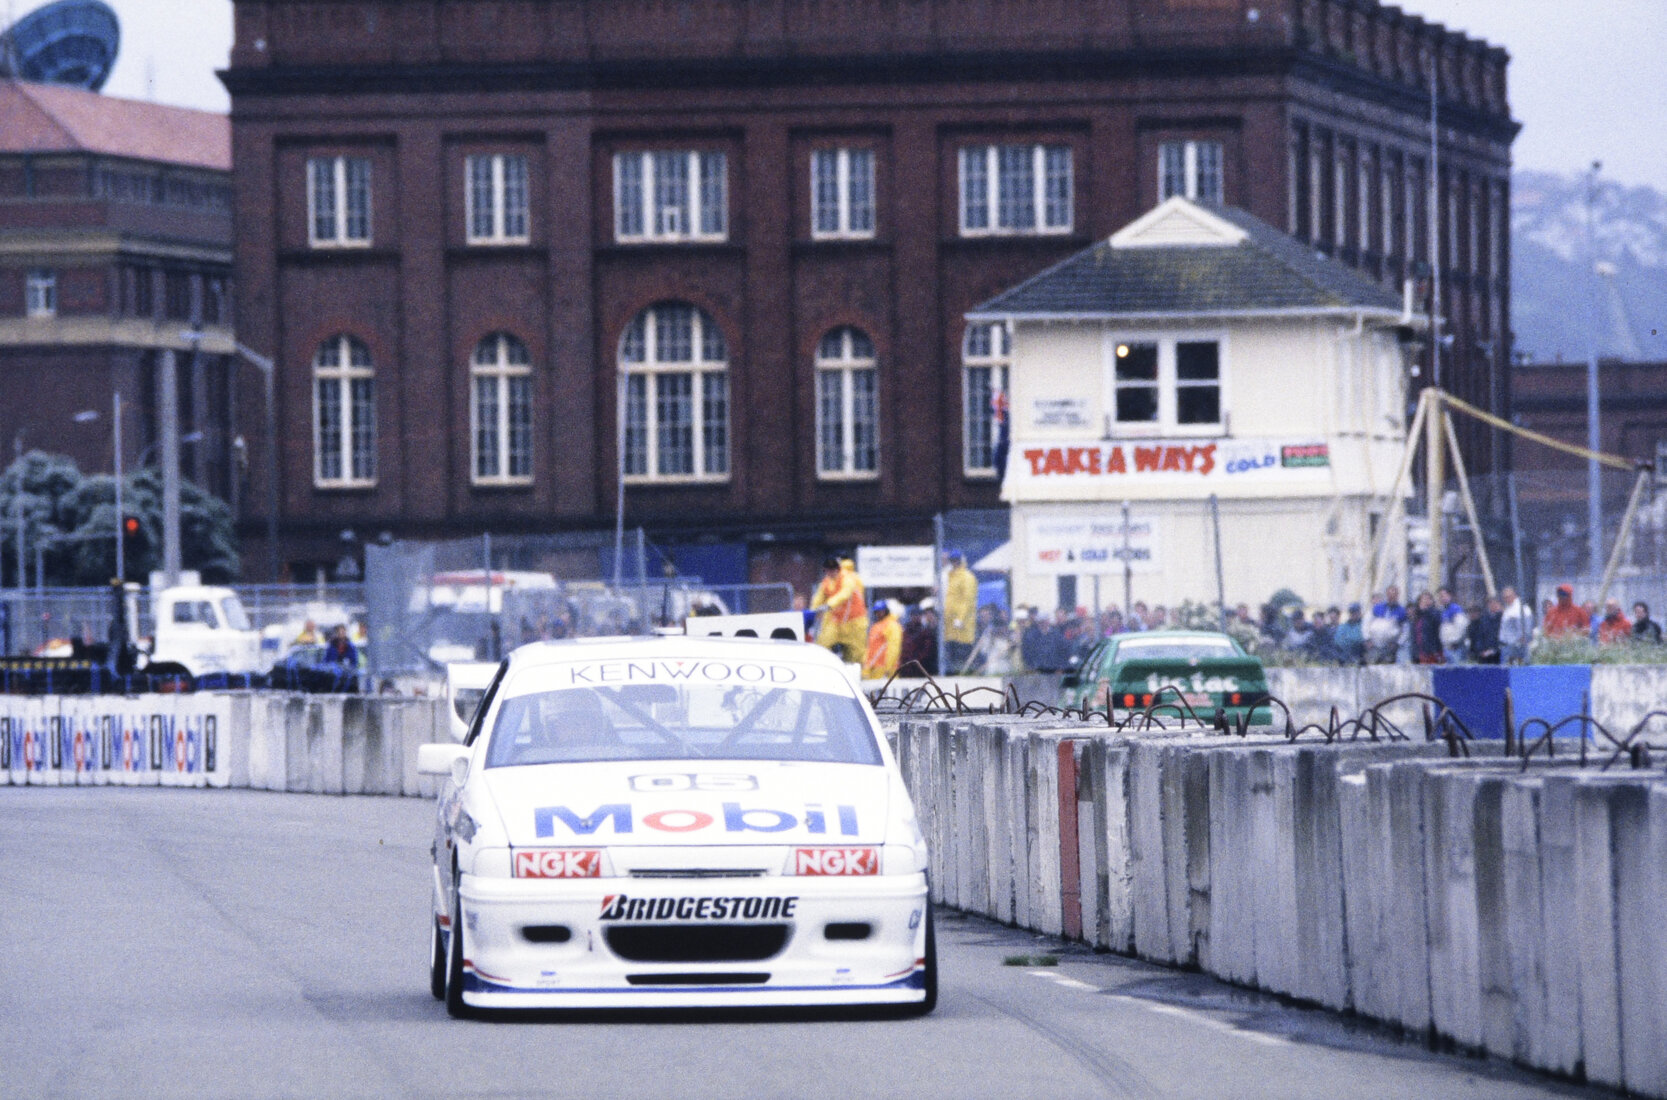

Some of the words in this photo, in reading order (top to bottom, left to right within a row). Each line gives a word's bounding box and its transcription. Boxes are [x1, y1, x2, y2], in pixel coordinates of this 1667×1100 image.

[1024, 447, 1100, 476] TAKE
[1107, 446, 1127, 474] A
[1134, 443, 1217, 476] WAYS
[1226, 454, 1275, 474] COLD
[570, 662, 797, 684] KENWOOD
[628, 773, 760, 792] 05
[534, 802, 859, 838] Mobil
[518, 852, 588, 878] NGK
[798, 850, 866, 875] NGK
[599, 894, 799, 920] BRIDGESTONE
